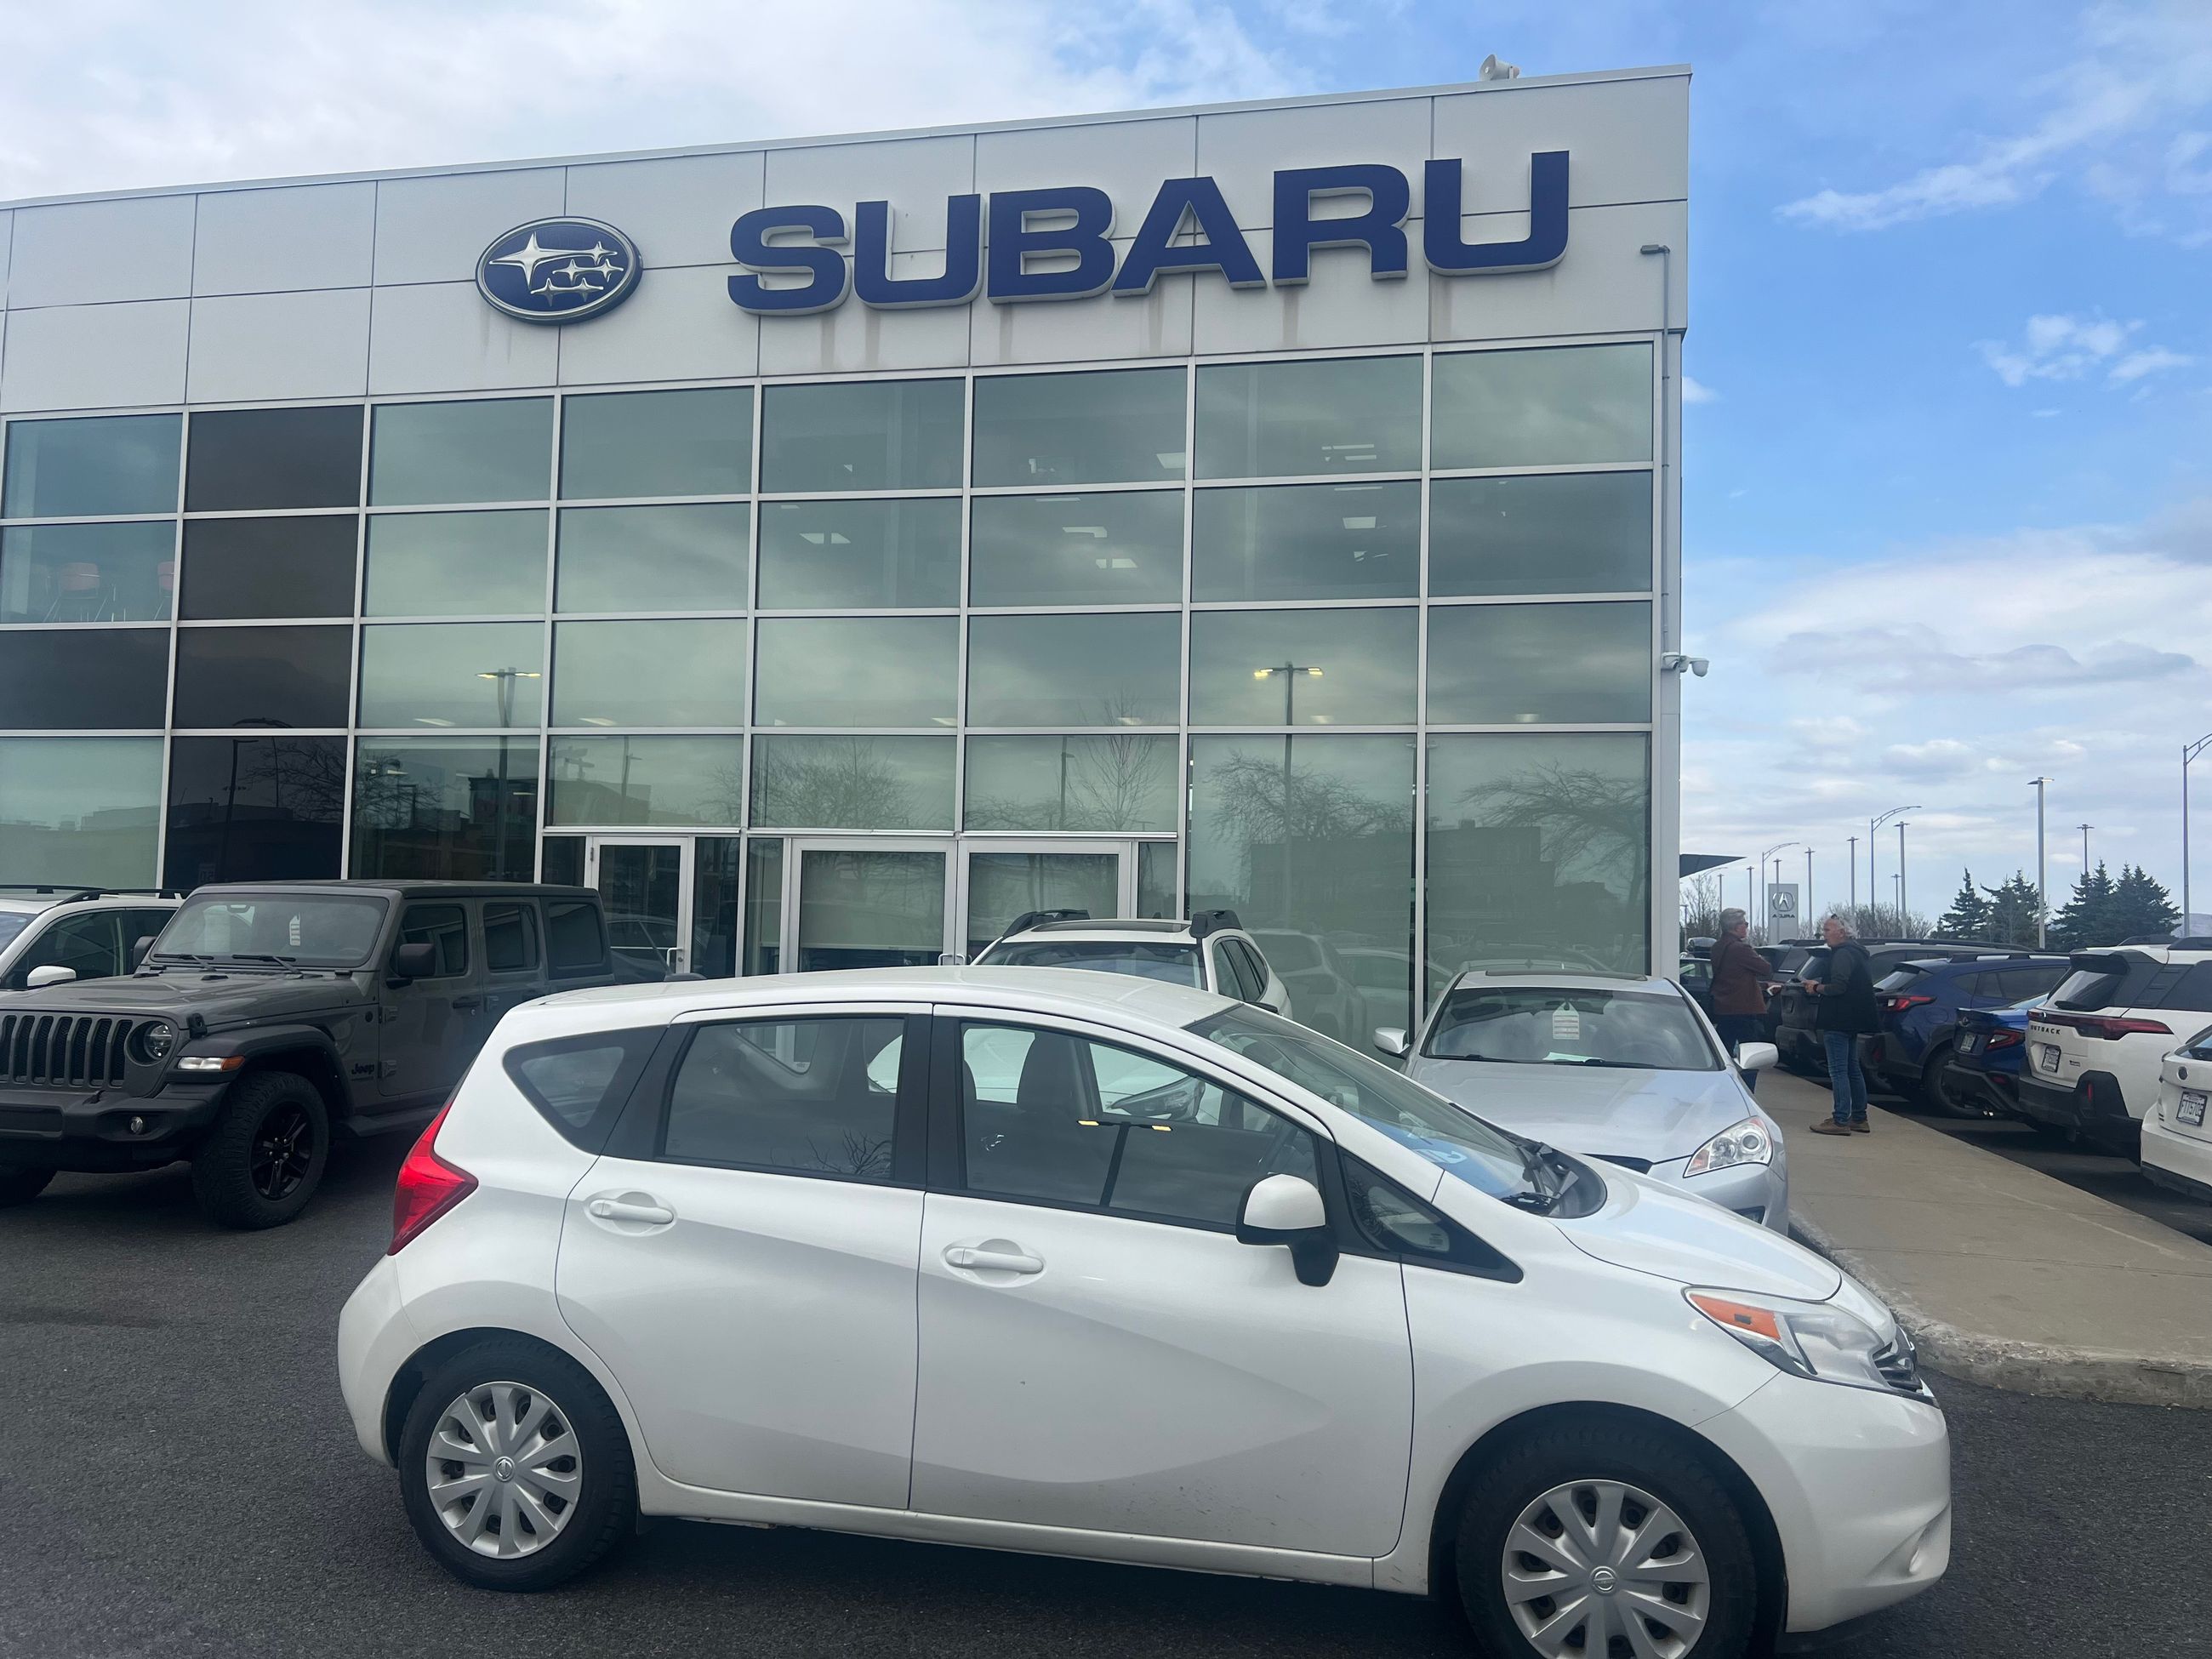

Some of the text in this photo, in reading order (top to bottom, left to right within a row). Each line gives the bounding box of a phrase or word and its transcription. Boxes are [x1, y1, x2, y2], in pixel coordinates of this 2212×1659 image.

[727, 150, 1570, 316] SUBARU
[2030, 1024, 2061, 1035] OUTBACK
[351, 1063, 375, 1075] Jeep
